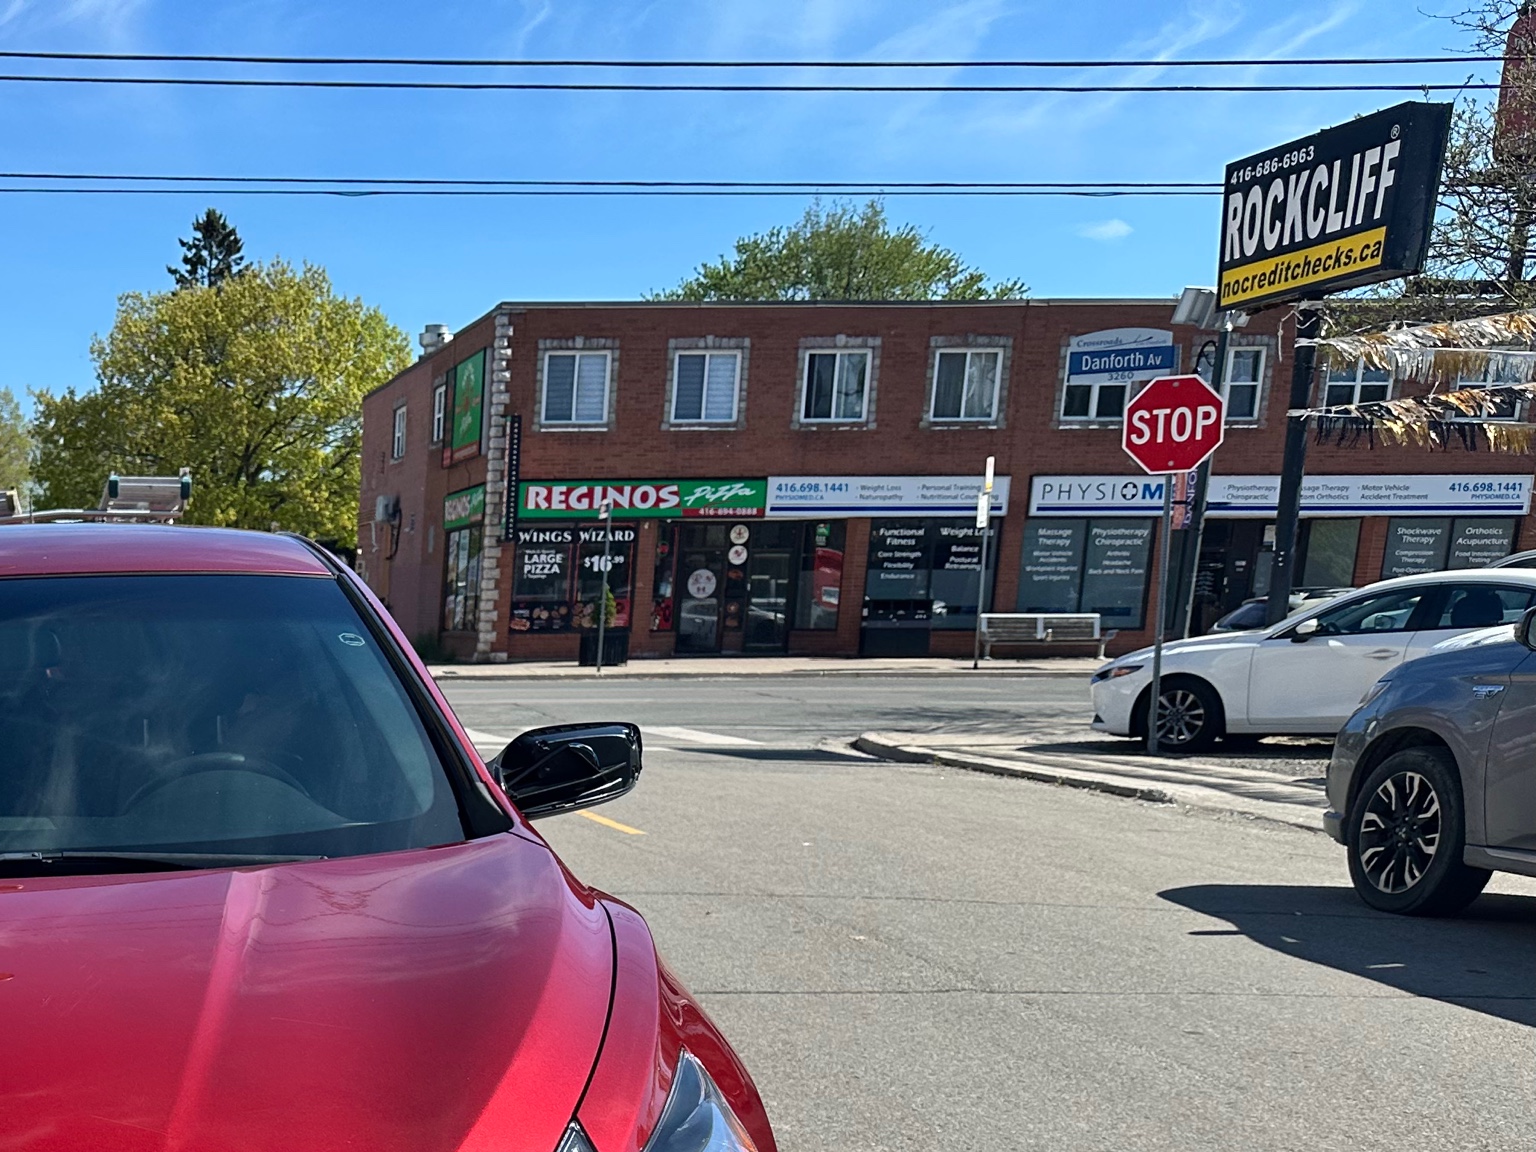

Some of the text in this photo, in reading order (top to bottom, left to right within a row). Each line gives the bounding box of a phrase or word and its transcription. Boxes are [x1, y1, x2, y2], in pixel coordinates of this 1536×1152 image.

[1230, 145, 1315, 186] 416-686-6963
[1224, 139, 1401, 263] ROCKCLIFF
[1222, 237, 1382, 300] nocreditchecks.ca
[1081, 351, 1163, 371] Danforth Av
[1107, 371, 1134, 381] 3260
[1130, 405, 1217, 445] STOP
[775, 482, 849, 493] 416.698.1441
[860, 485, 884, 493] Weight
[953, 484, 982, 492] Training
[1227, 484, 1277, 492] Physiotherapy
[1321, 484, 1350, 492] Therapy
[1448, 482, 1523, 492] 416.698.1441
[526, 482, 756, 510] REGINOS Pizza
[859, 493, 904, 502] Naturopathy
[1226, 493, 1269, 501] Chiropractic
[518, 528, 635, 544] WINGS WIZARD
[879, 527, 925, 536] Functional
[939, 527, 973, 538] Weight
[1037, 528, 1073, 538] Massage
[1091, 528, 1150, 538] Physiotherapy
[1396, 527, 1442, 536] Shockwave
[1465, 527, 1503, 535] Orthotics
[885, 537, 916, 546] Fitness
[1038, 538, 1071, 547] Therapy
[1094, 538, 1144, 547] Chiropractic
[1401, 536, 1436, 545] Therapy
[1456, 537, 1509, 546] Acupuncture
[524, 553, 563, 564] LARGE
[524, 564, 561, 574] PIZZA
